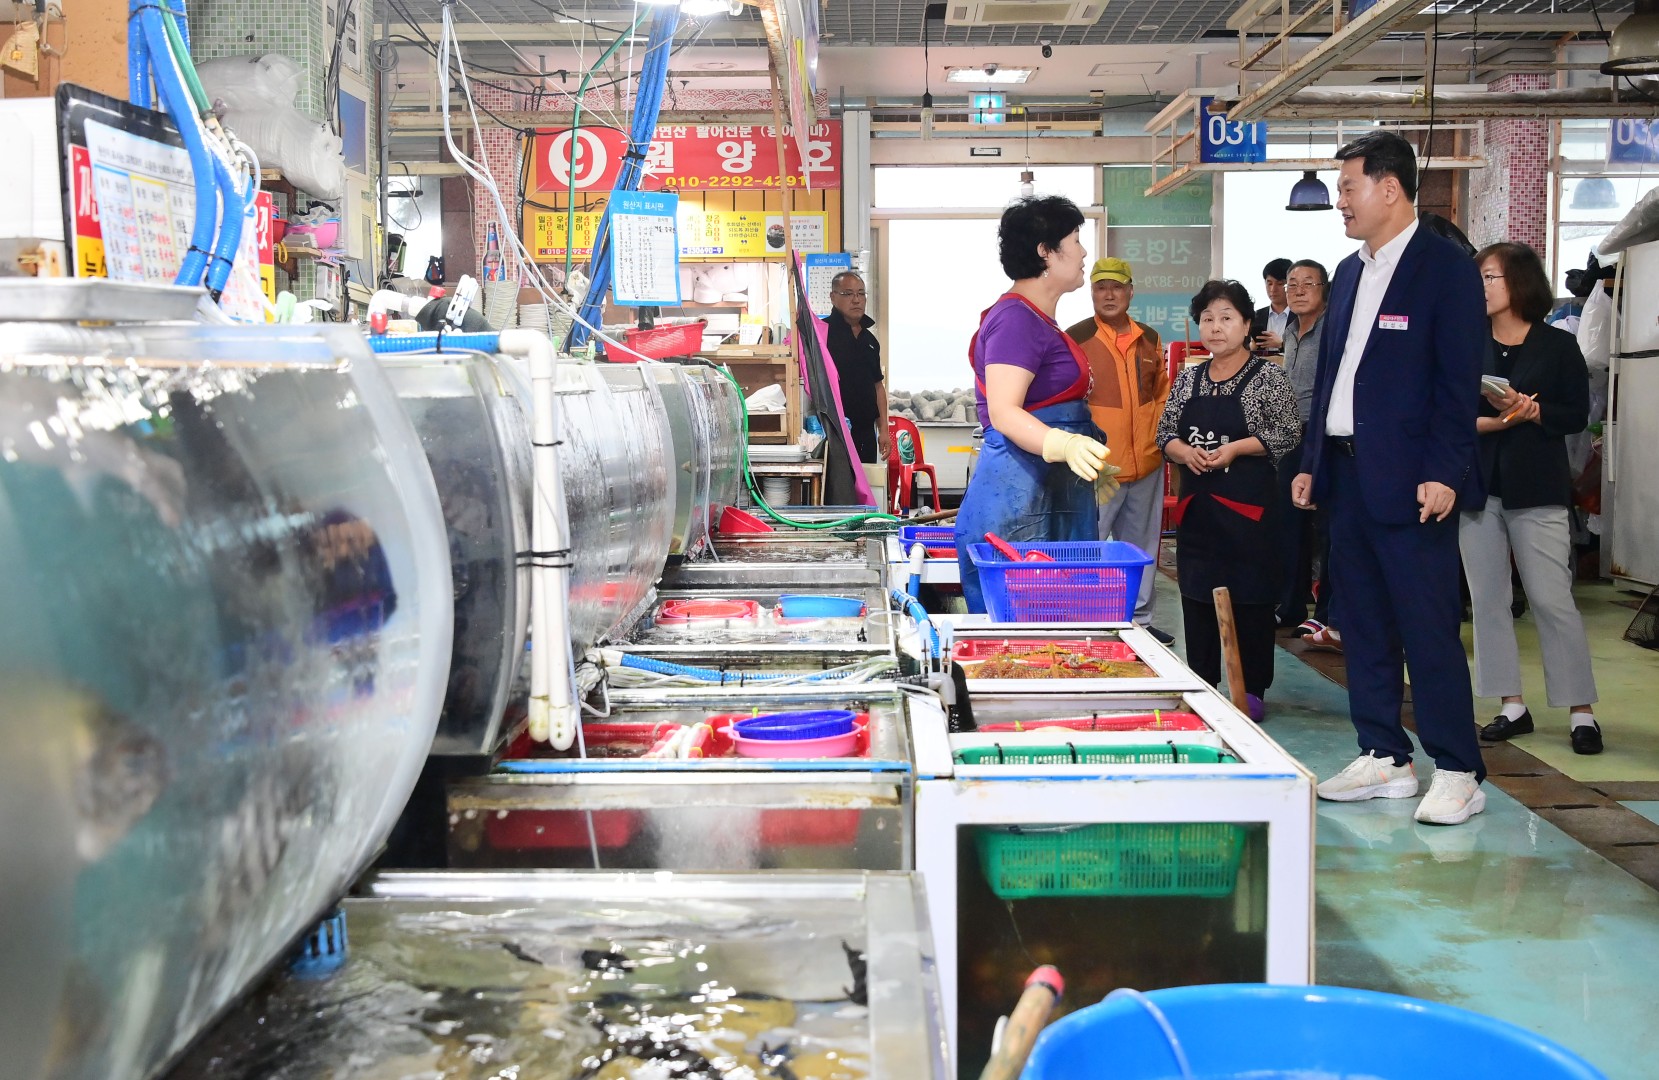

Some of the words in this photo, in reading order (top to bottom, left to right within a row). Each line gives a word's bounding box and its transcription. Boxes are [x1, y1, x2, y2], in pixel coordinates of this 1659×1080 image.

[696, 125, 752, 138] 활어전문
[1208, 115, 1257, 145] 031
[622, 200, 643, 210] 원산지
[644, 202, 665, 211] 표시판
